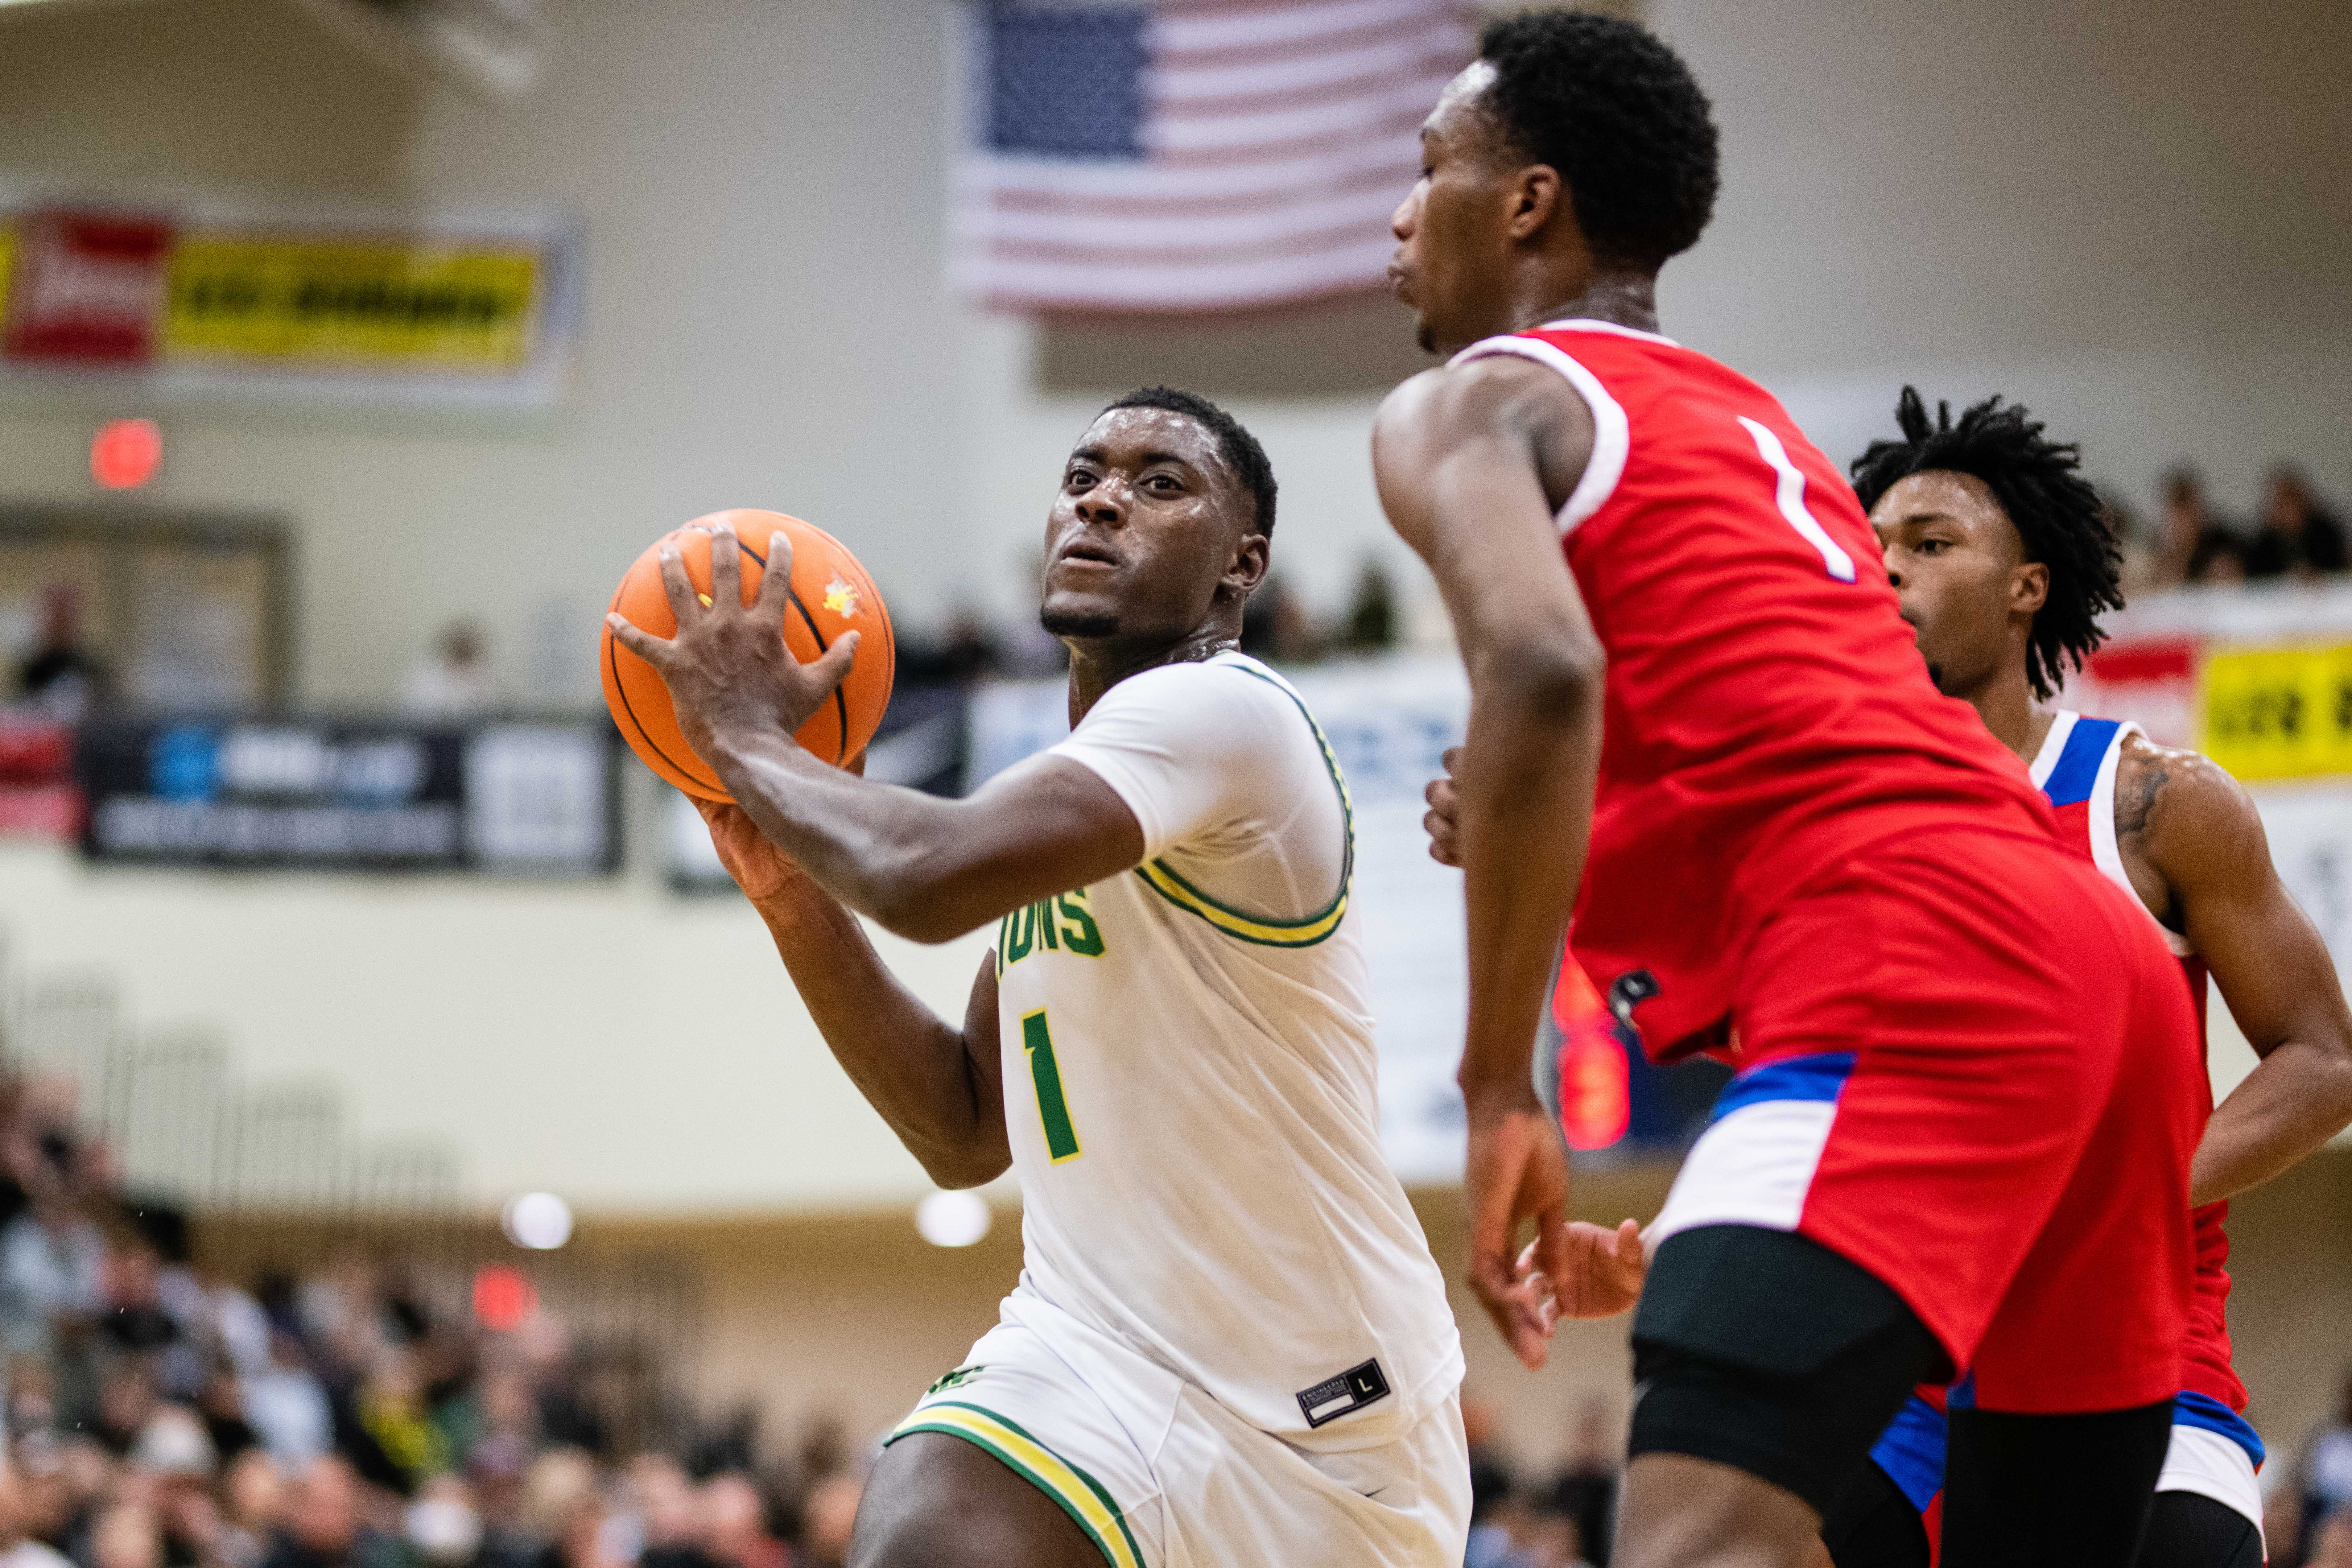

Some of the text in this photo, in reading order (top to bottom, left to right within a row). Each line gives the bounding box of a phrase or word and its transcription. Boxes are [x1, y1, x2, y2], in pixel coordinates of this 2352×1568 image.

[1737, 415, 1857, 584] 1
[1020, 1006, 1083, 1165] 1
[1358, 1378, 1373, 1392] L
